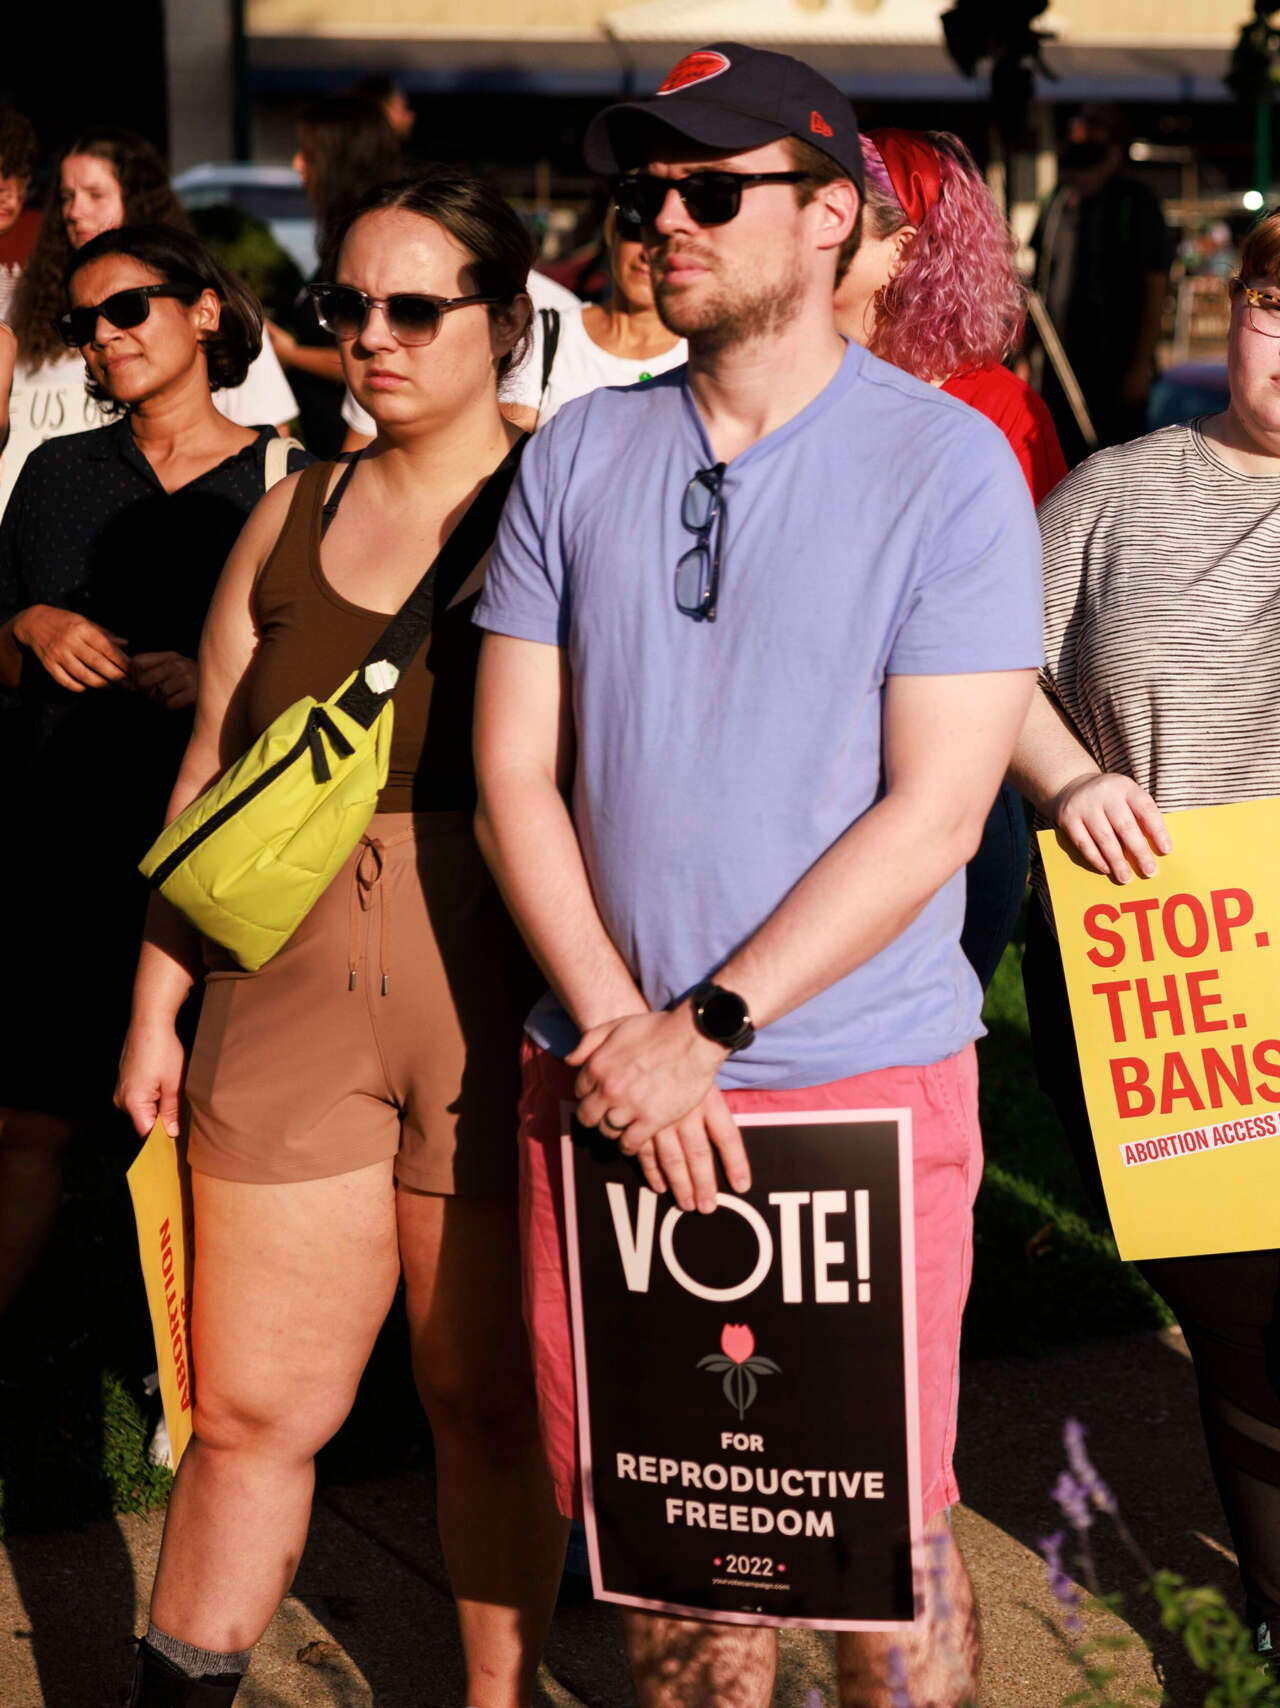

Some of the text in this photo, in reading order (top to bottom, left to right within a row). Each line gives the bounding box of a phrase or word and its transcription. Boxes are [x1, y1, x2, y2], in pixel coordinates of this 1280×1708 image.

[1083, 887, 1270, 968] STOP.
[1091, 969, 1247, 1043] THE.
[1125, 1131, 1209, 1165] ABORTION
[1213, 1115, 1277, 1146] ACCESS
[605, 1182, 871, 1303] VOTE!
[159, 1216, 190, 1412] ABORTION
[721, 1432, 764, 1452] FOR
[616, 1452, 885, 1499] REPRODUCTIVE
[666, 1498, 834, 1537] FREEDOM
[726, 1554, 774, 1577] 2022
